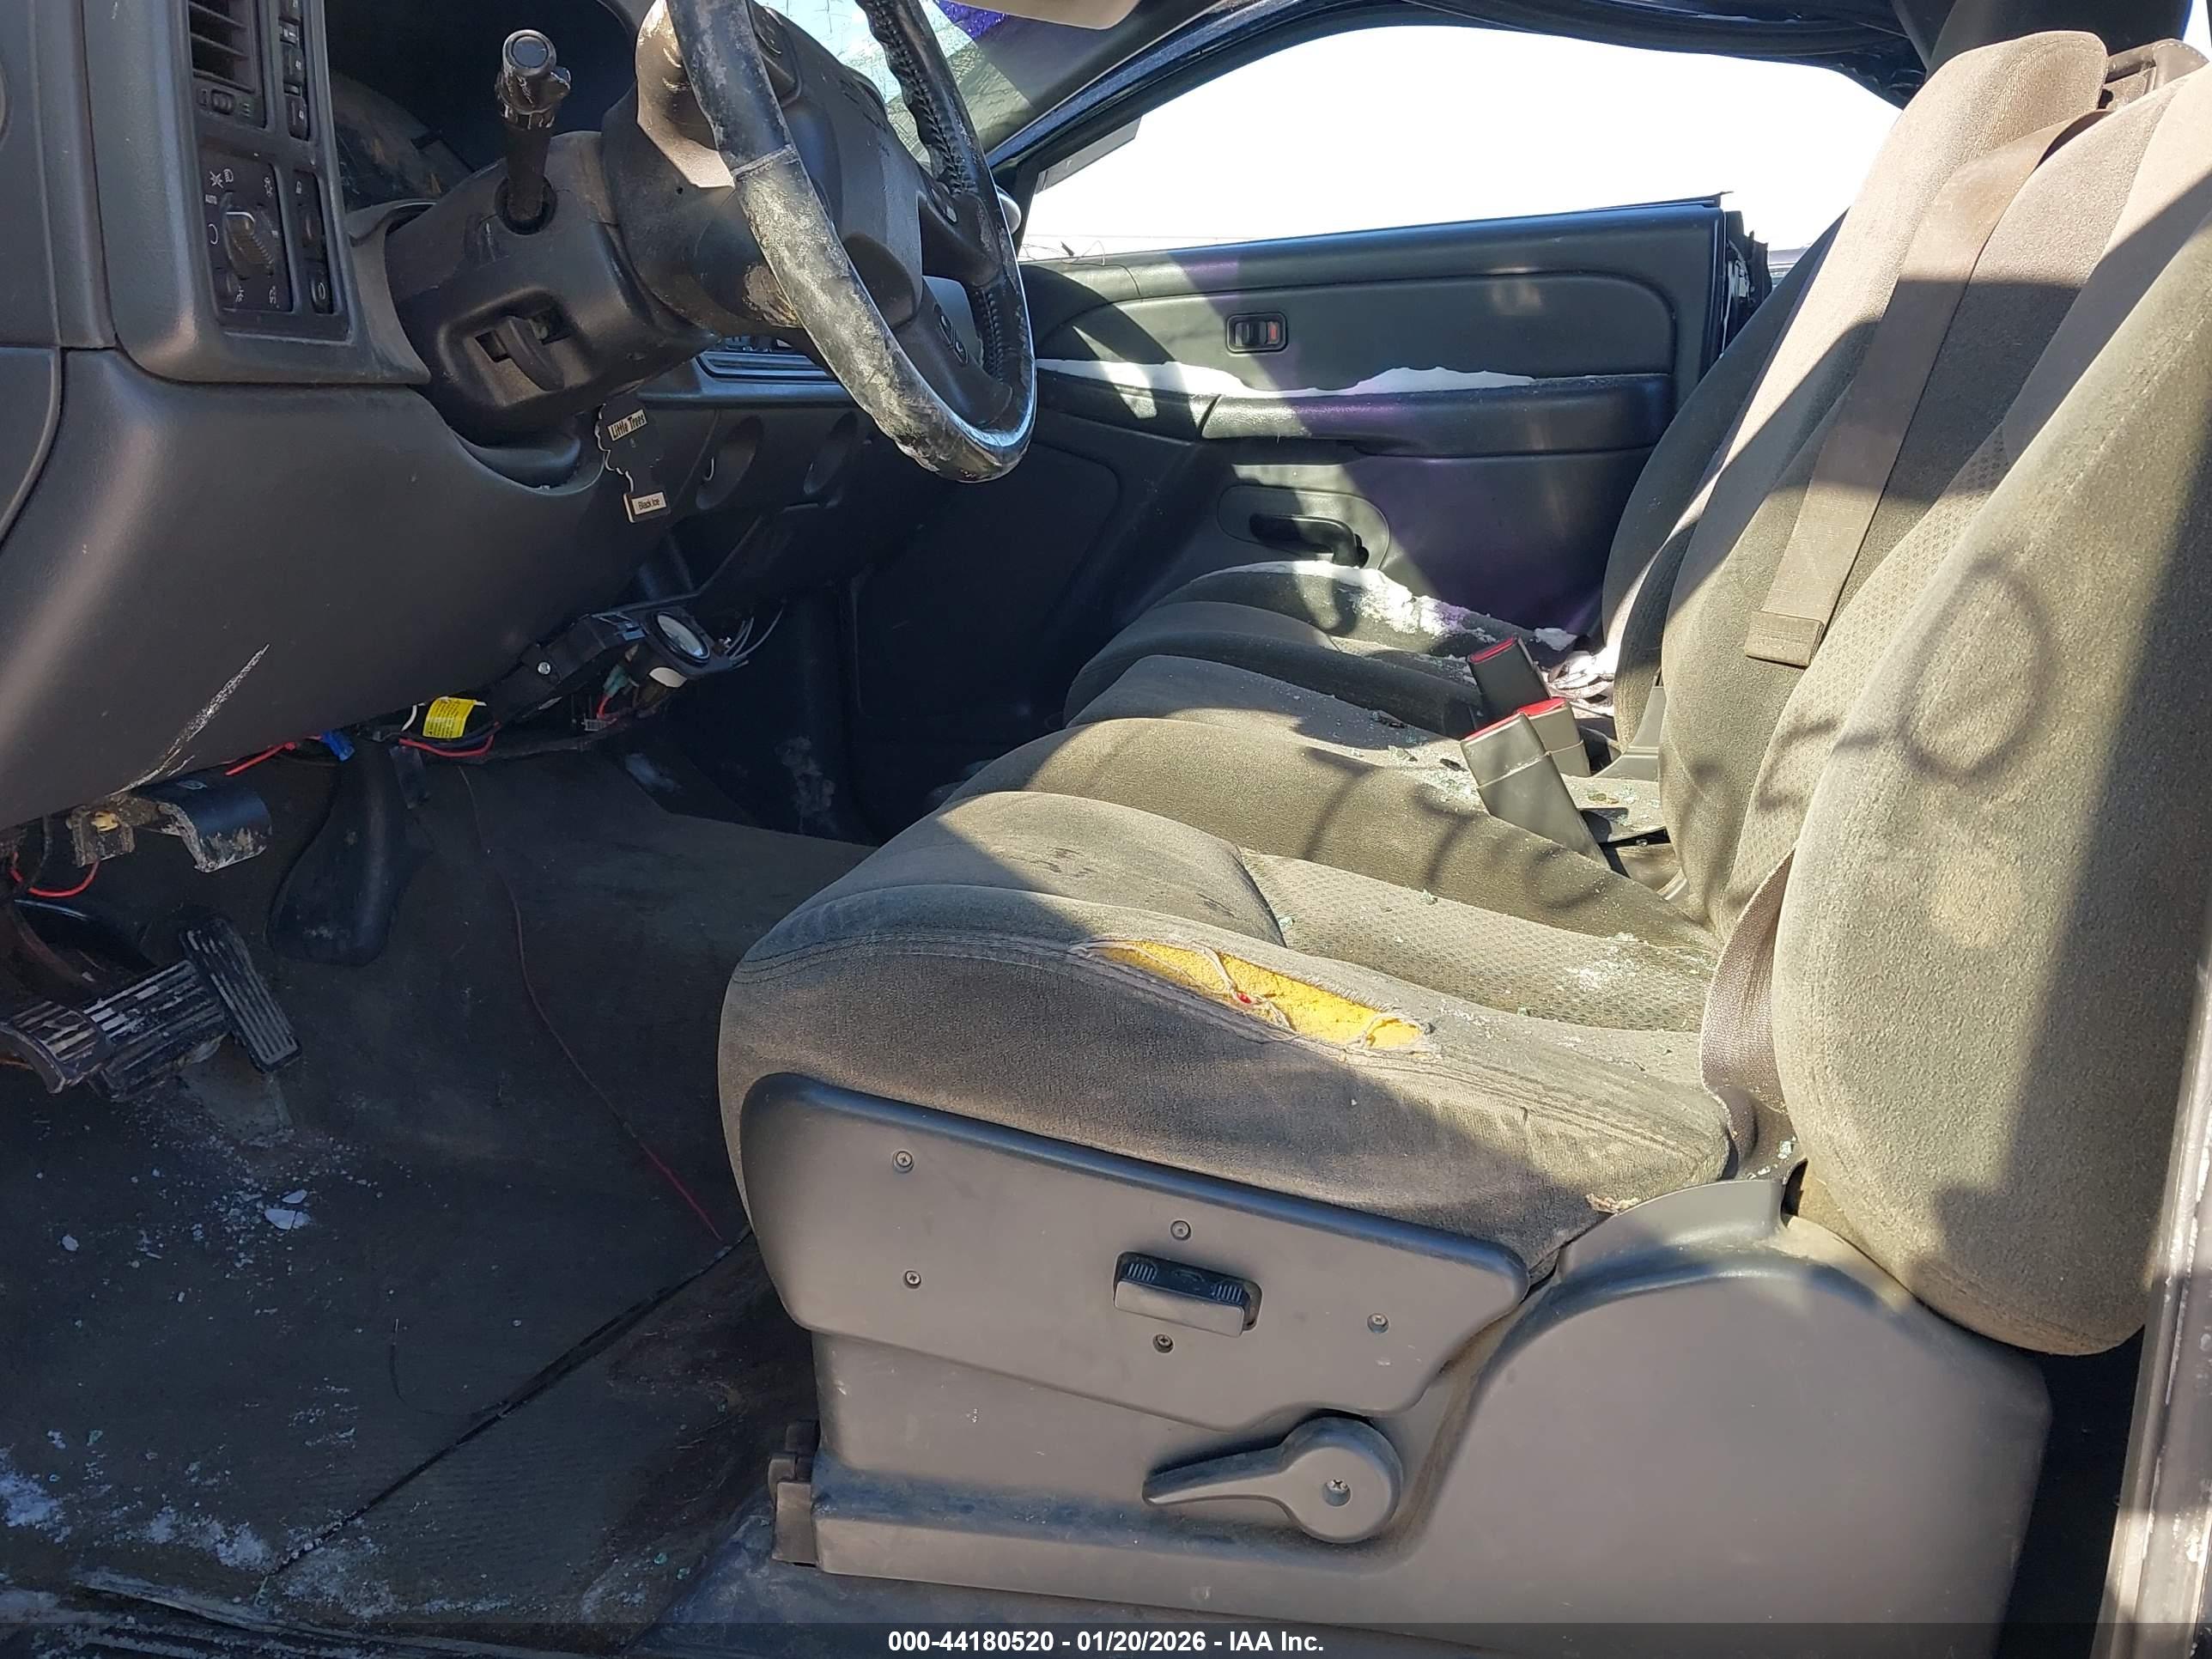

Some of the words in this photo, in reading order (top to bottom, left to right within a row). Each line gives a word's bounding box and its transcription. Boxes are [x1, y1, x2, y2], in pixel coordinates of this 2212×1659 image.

[611, 420, 629, 439] Little
[628, 414, 645, 430] Trees
[638, 500, 652, 510] Black
